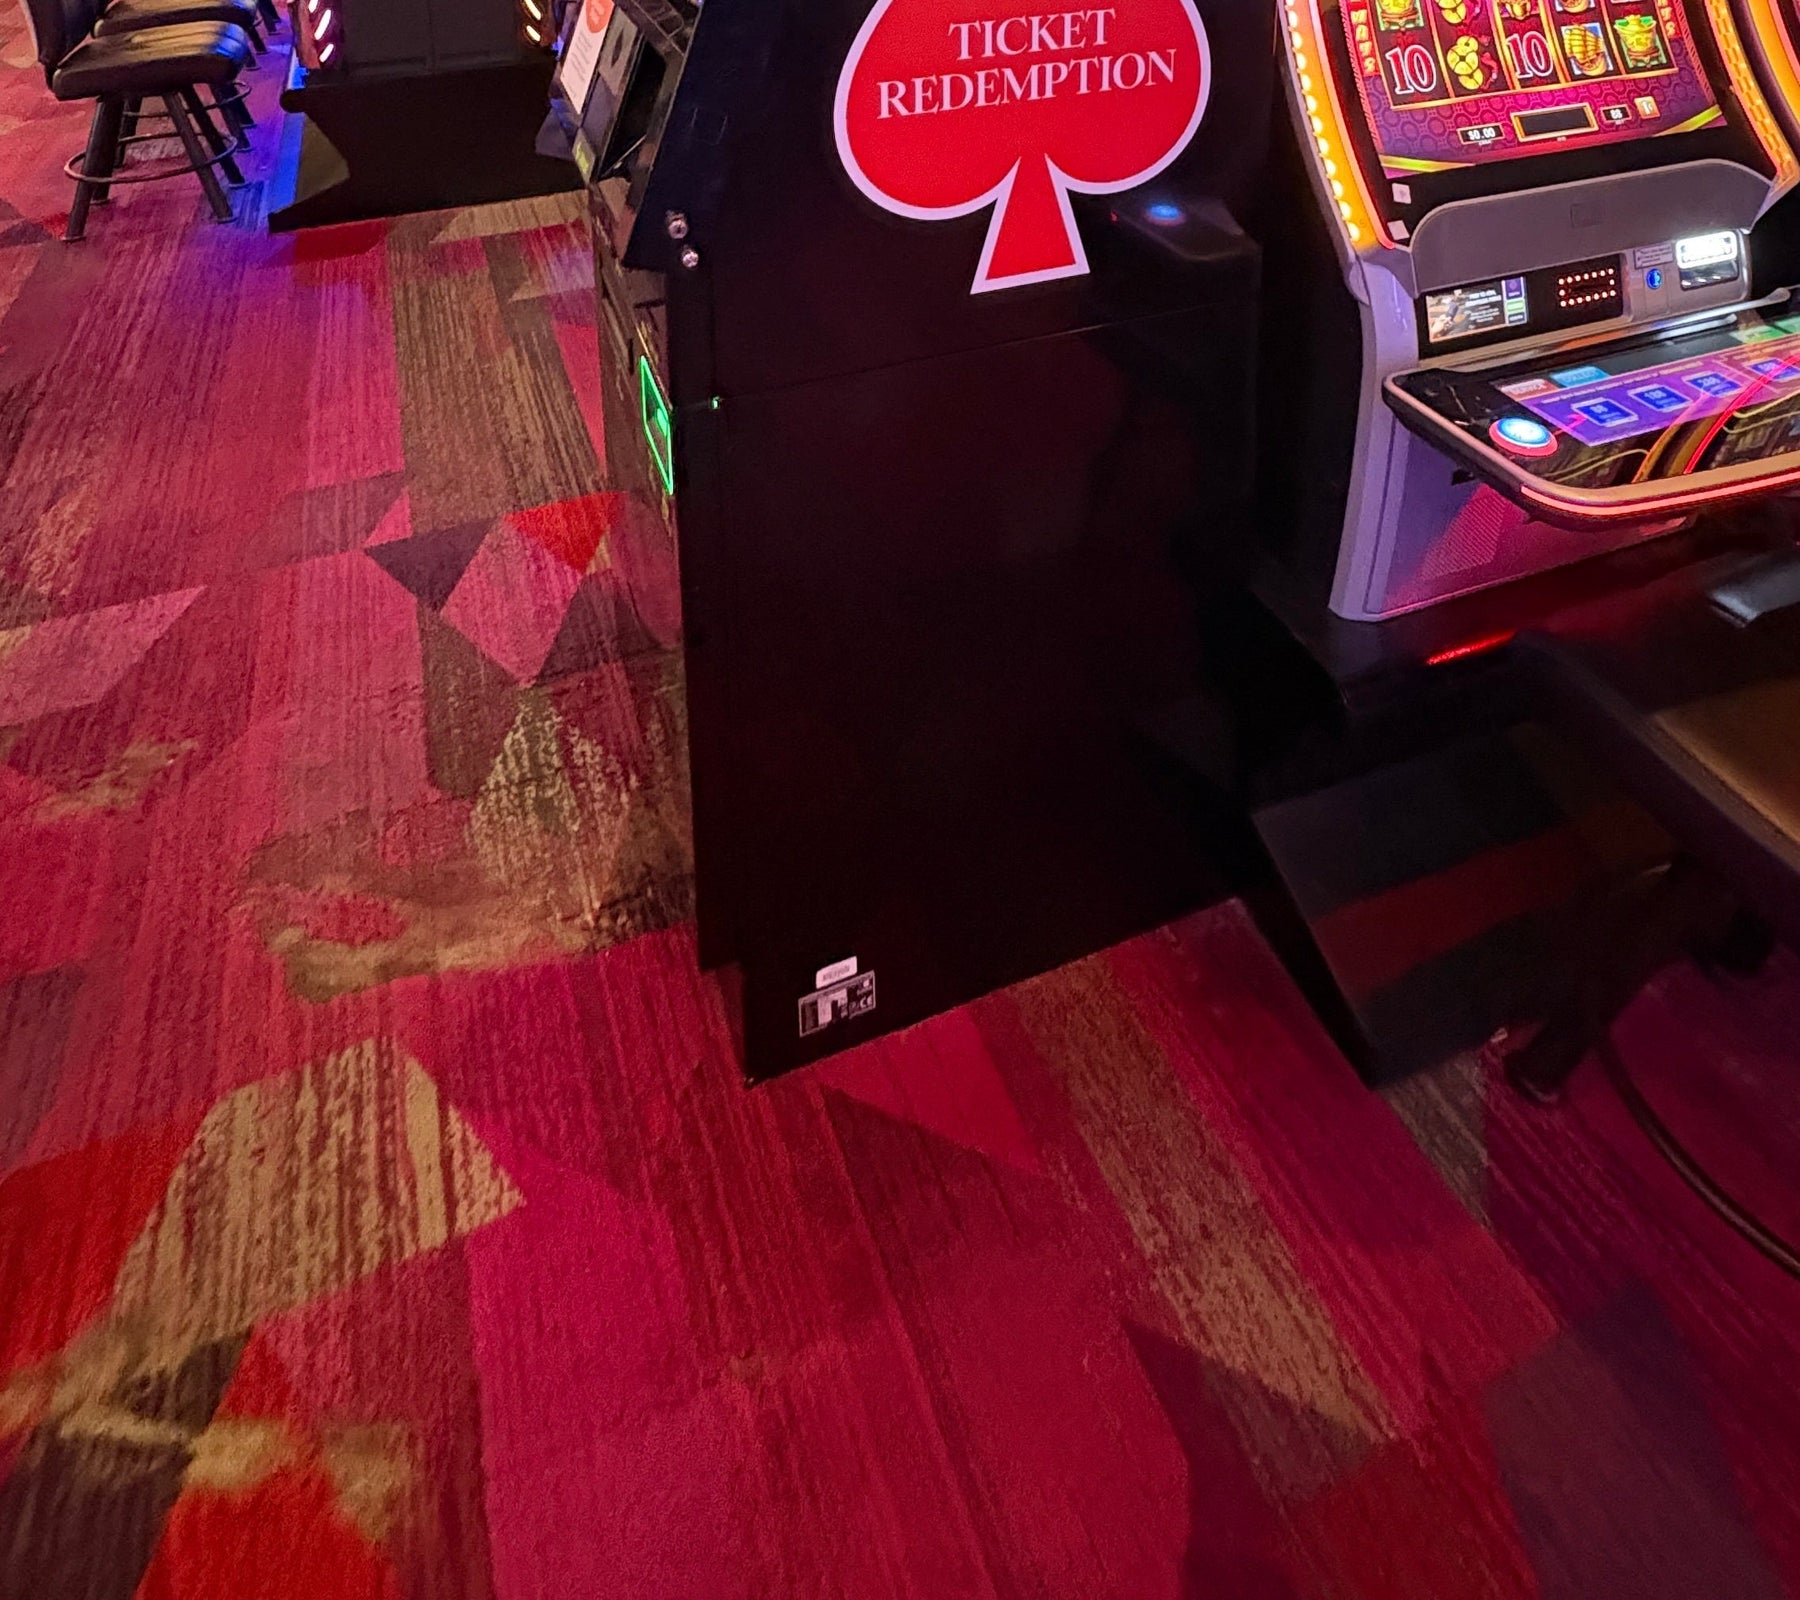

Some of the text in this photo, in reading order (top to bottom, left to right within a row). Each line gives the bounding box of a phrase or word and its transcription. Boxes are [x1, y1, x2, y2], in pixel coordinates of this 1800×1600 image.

[948, 8, 1115, 61] TICKET
[1507, 31, 1553, 78] 10
[877, 49, 1177, 119] REDEMPTION
[1386, 44, 1436, 94] 10
[1467, 127, 1495, 140] $0.00
